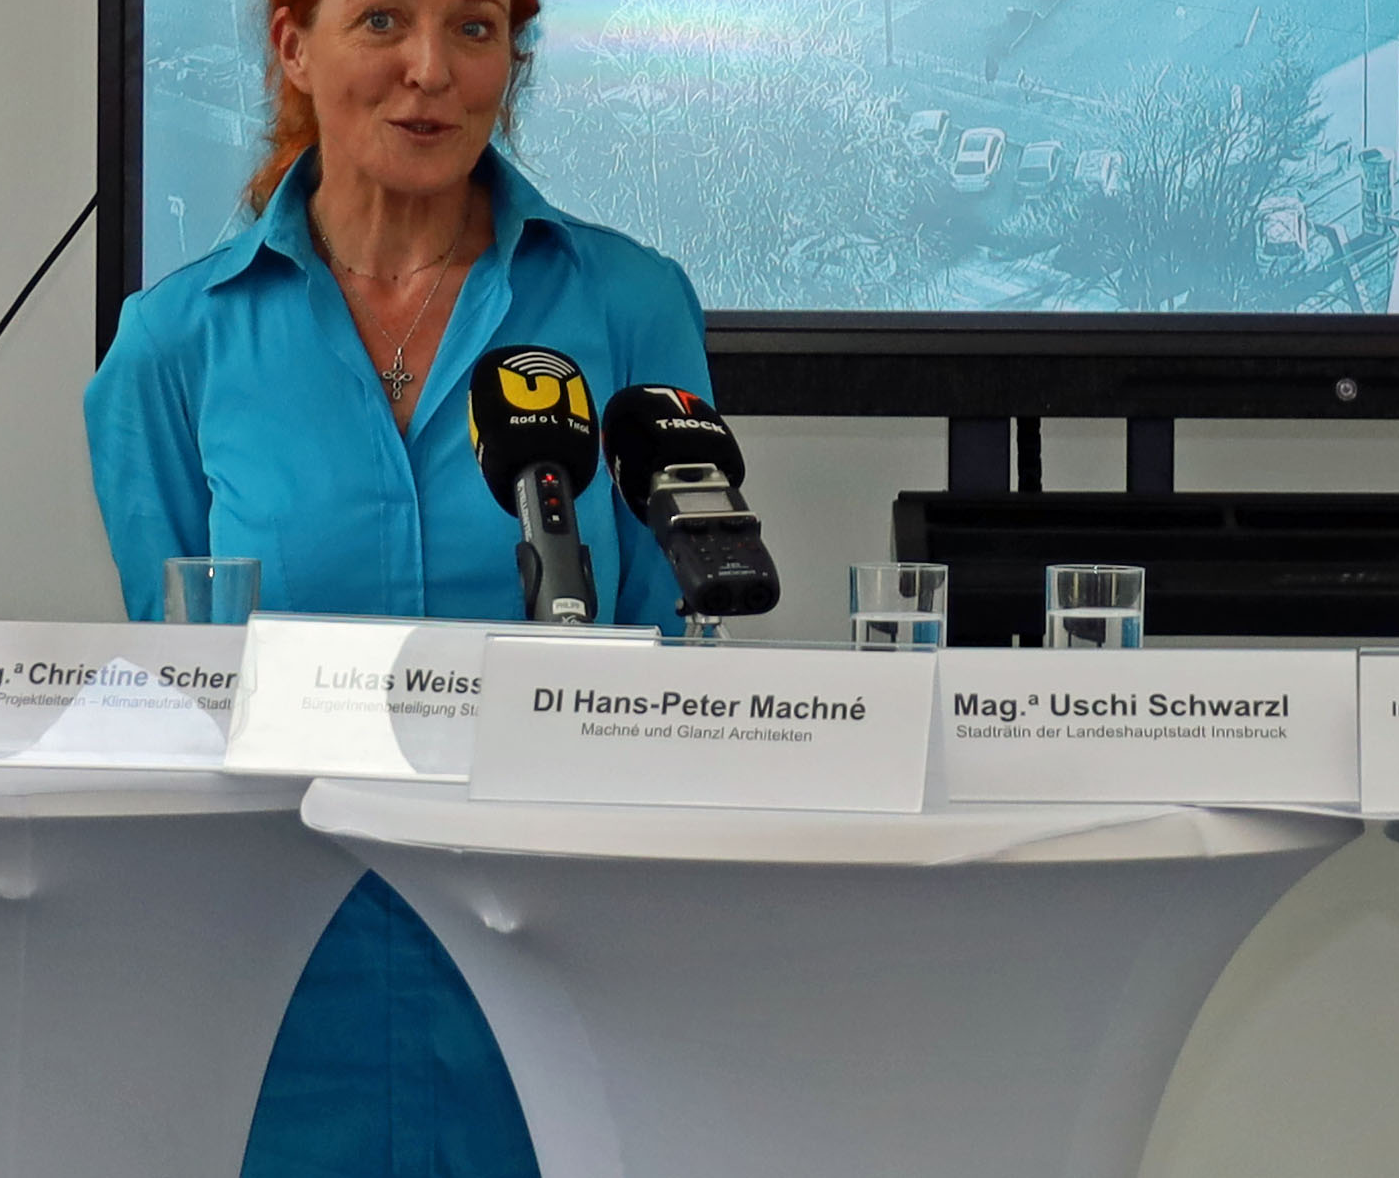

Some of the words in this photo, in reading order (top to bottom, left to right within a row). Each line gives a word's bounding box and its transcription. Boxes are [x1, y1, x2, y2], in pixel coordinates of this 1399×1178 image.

[655, 418, 727, 435] T-ROCK
[28, 661, 150, 690] Christine
[313, 665, 396, 693] Lukas
[405, 668, 483, 696] Weiss
[101, 695, 194, 711] Klimaneutrale
[196, 696, 233, 711] Stadt
[459, 702, 481, 717] St
[532, 688, 564, 713] DI
[573, 689, 741, 718] Hans-Peter
[749, 695, 867, 721] Machné
[1049, 693, 1138, 718] Uschi
[1147, 693, 1290, 719] Schwarzl
[580, 722, 640, 738] Machné
[644, 724, 673, 739] und
[676, 724, 725, 740] Glanzl
[728, 726, 814, 743] Architekten
[955, 724, 1032, 740] Stadträtin
[1035, 724, 1062, 740] der
[1065, 724, 1207, 742] Landeshauptstadt
[1210, 724, 1289, 740] Innsbruck
